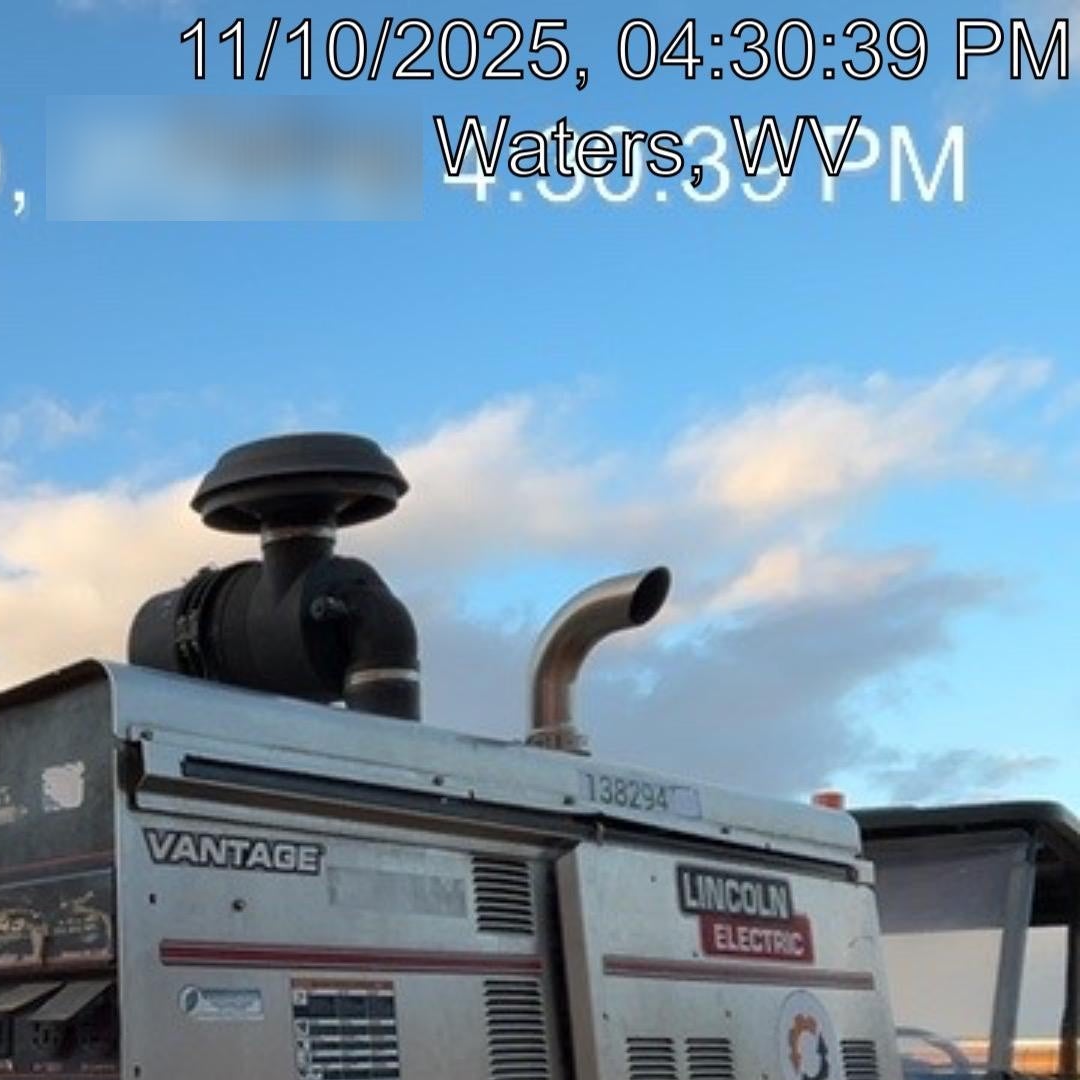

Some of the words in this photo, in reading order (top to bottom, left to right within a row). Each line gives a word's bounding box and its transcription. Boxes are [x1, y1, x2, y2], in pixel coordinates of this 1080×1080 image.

[585, 773, 670, 812] 138294
[143, 828, 323, 875] VANTAGE
[682, 871, 789, 920] LINCOLN
[713, 922, 806, 955] ELECTRIC
